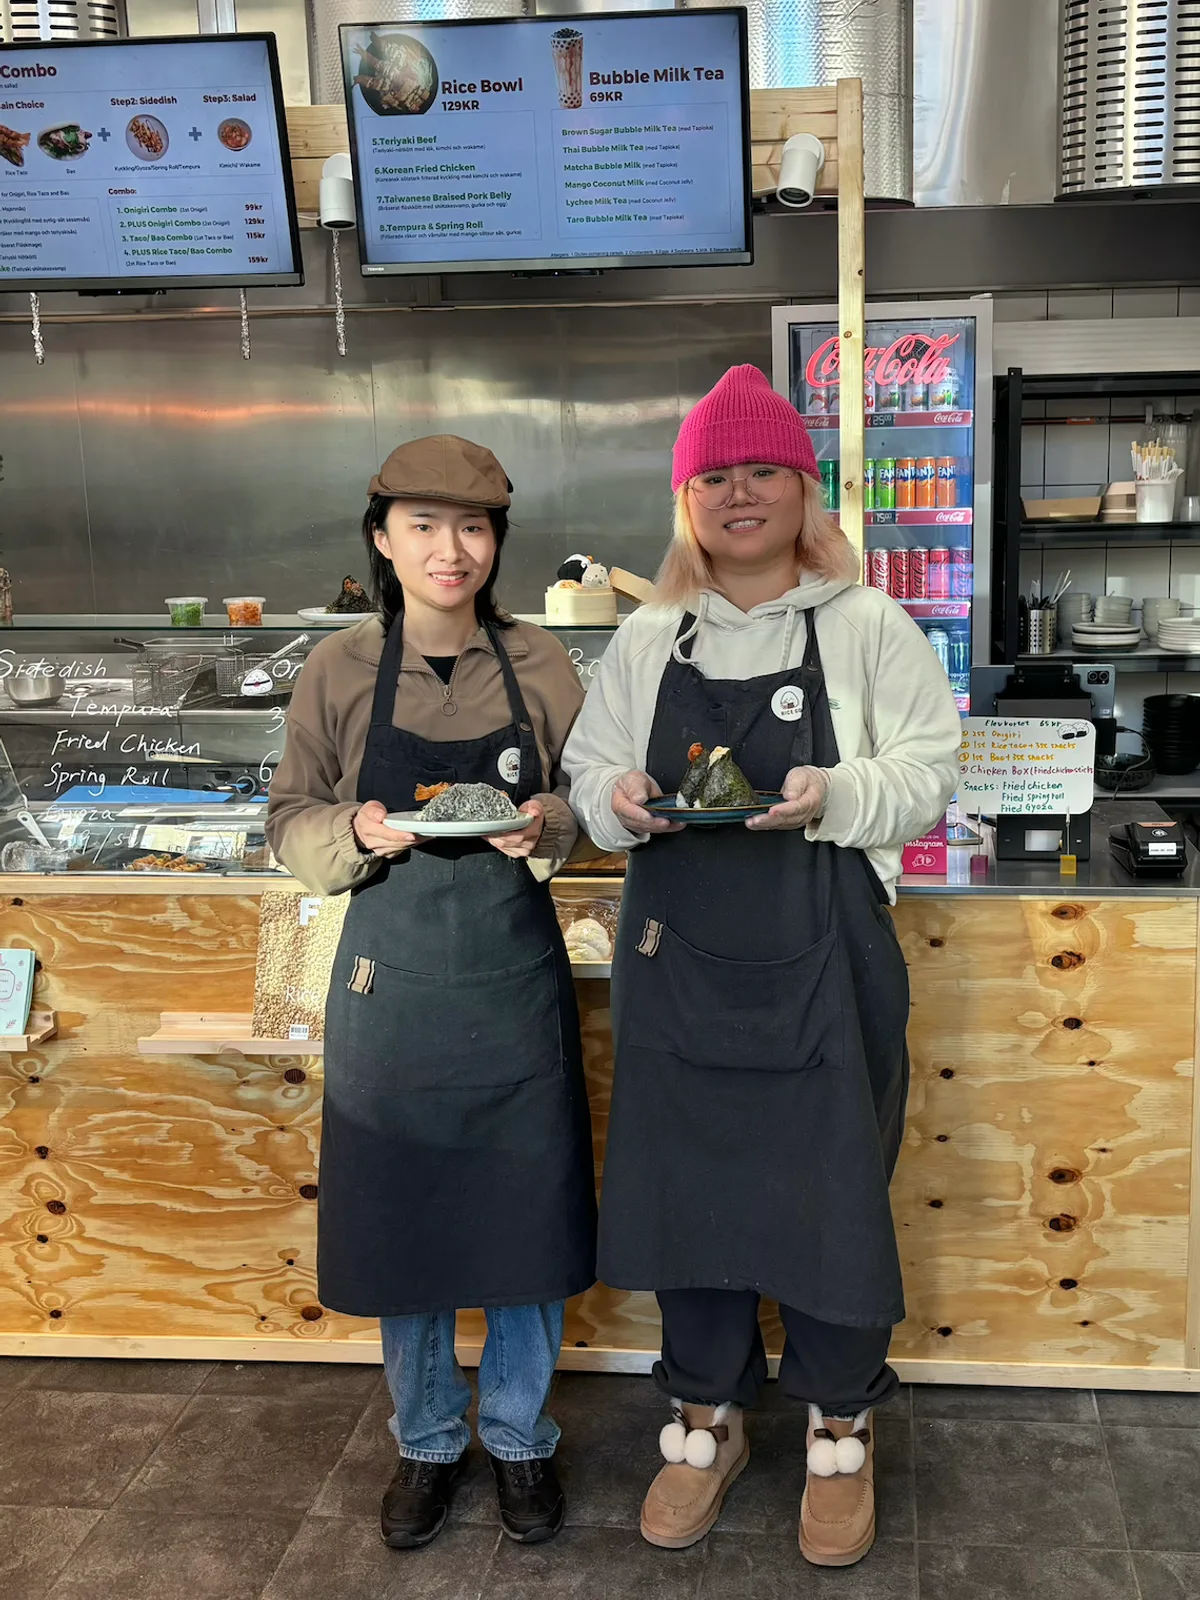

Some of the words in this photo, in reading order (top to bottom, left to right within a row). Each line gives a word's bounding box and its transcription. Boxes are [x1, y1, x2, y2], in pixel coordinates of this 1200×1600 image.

[0, 64, 56, 78] Combo
[590, 70, 650, 86] Bubble
[654, 68, 690, 83] Milk
[694, 66, 724, 80] Tea
[442, 80, 476, 94] Rice
[481, 78, 523, 93] Bowl
[111, 97, 138, 107] Step2:
[140, 96, 177, 105] Sidedish
[203, 95, 230, 103] Step3:
[232, 93, 256, 102] Salad
[590, 91, 622, 102] 69KR
[16, 100, 44, 108] Choice
[442, 100, 480, 111] 129KR
[590, 128, 612, 137] Sugar
[372, 136, 415, 146] 5.Teriyaki
[417, 136, 437, 144] Beef
[375, 166, 414, 175] 6.Korean
[565, 181, 591, 189] Mango
[377, 195, 431, 204] 7.Taiwanese
[433, 193, 466, 201] Braised
[490, 191, 512, 200] Belly
[566, 199, 593, 207] Lychee
[124, 206, 149, 215] Onigiri
[148, 220, 174, 229] Onigiri
[380, 224, 426, 233] 8.Tempura
[436, 222, 464, 231] Spring
[806, 334, 960, 387] Coa-Cola
[68, 696, 174, 727] Tempura
[992, 730, 1021, 741] Onigiri
[51, 729, 110, 755] Fried
[120, 734, 201, 756] Chicken
[1028, 753, 1054, 761] snacks
[970, 765, 1008, 776] Chicken
[44, 762, 106, 796] Spring
[120, 766, 170, 786] Roll
[964, 781, 999, 791] Snacks:
[1003, 780, 1025, 790] Fried
[1027, 781, 1062, 790] chicken
[1002, 793, 1023, 802] Fried
[1001, 804, 1022, 813] Fried
[1025, 803, 1053, 811] Gyoza
